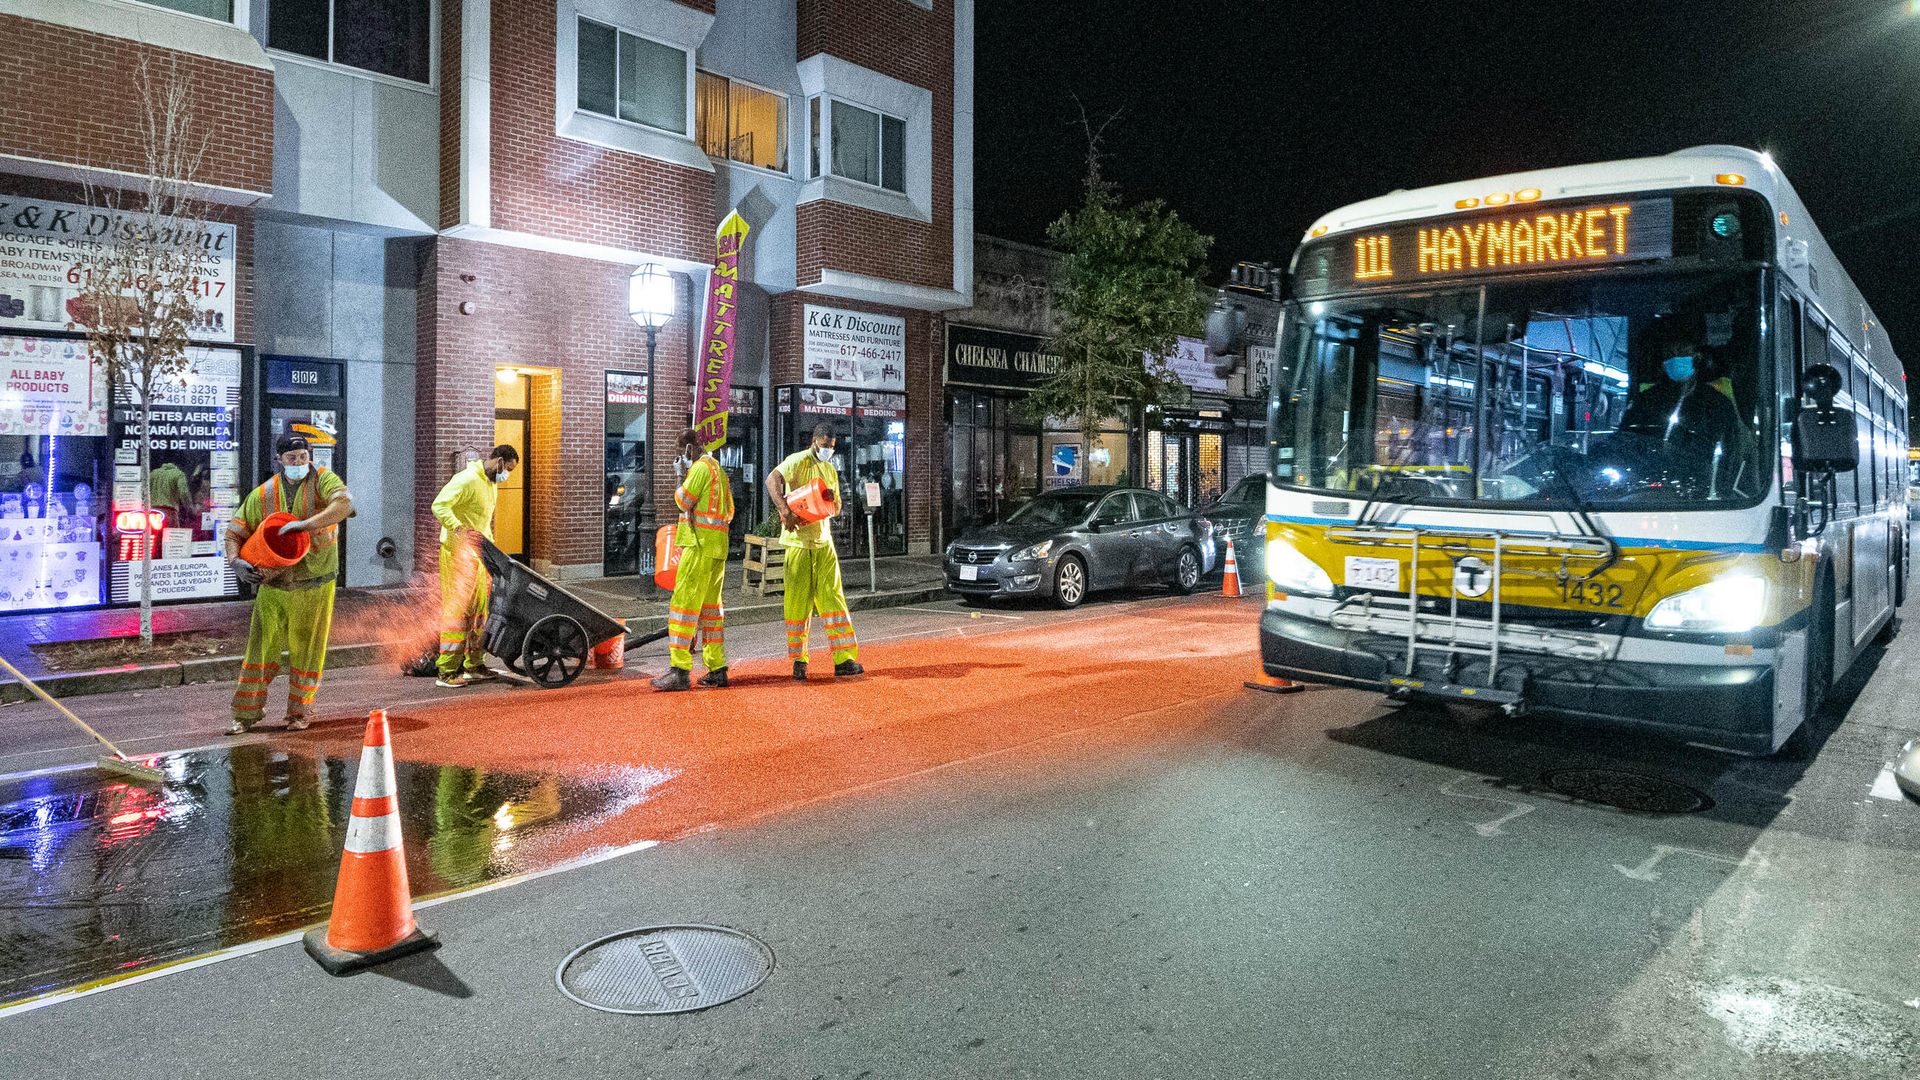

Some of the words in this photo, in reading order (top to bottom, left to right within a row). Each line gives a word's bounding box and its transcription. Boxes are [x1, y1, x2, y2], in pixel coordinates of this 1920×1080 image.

[13, 205, 42, 229] &
[46, 209, 76, 233] K
[66, 239, 103, 252] GIFTS
[1354, 235, 1393, 280] 111
[1417, 205, 1632, 273] HAYMARKET
[29, 249, 70, 262] ITEMS
[1, 260, 62, 272] BROADWAY
[38, 274, 63, 282] 02150
[808, 311, 819, 325] K
[820, 312, 831, 327] &
[832, 314, 843, 329] K
[846, 316, 902, 336] Discount
[702, 261, 738, 412] MATTRESS
[808, 329, 850, 342] MATTRESSES
[851, 335, 866, 343] AND
[866, 336, 901, 348] FURNITURE
[840, 345, 902, 362] 617-466-2417
[955, 343, 1009, 370] CHELSEA
[10, 369, 31, 380] ALL
[34, 370, 65, 381] BABY
[292, 371, 317, 384] 302
[6, 382, 69, 393] PRODUCTS
[191, 384, 218, 395] 3236
[166, 394, 187, 404] 461
[191, 395, 217, 405] 8671
[607, 394, 647, 404] DINING
[736, 406, 754, 414] SET
[803, 405, 847, 415] MATTRESS
[185, 412, 232, 422] AEREOS
[181, 423, 231, 436] PÚBLICA
[170, 439, 187, 450] DE
[189, 439, 233, 450] DINERO
[1460, 565, 1485, 591] T
[156, 586, 196, 594] CRUCEROS
[1557, 580, 1623, 608] 1432
